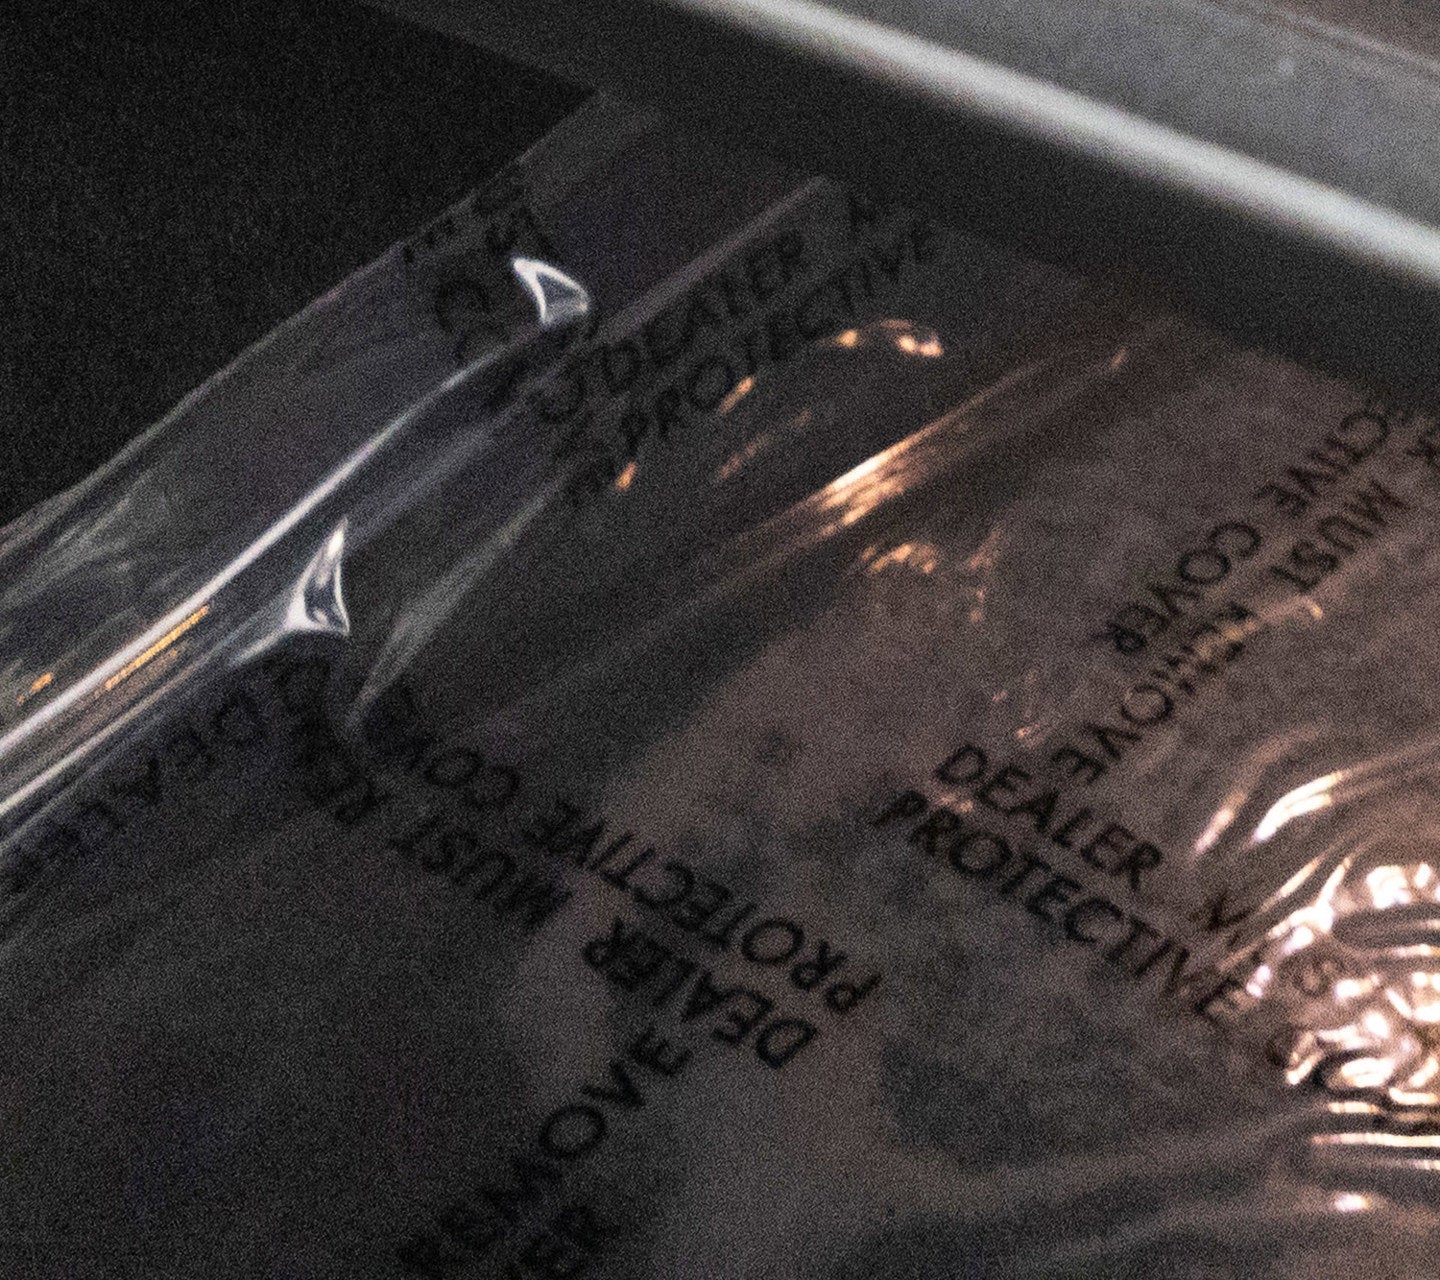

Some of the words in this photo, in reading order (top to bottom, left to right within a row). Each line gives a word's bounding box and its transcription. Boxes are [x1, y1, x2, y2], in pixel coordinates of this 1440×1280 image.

[1082, 518, 1262, 658] COVER
[1268, 478, 1406, 596] MUST
[930, 742, 1164, 896] DEALER
[522, 796, 884, 1018] PROTECTIVE
[868, 790, 1244, 1026] PROTECTIVE
[581, 918, 822, 1072] DEALER
